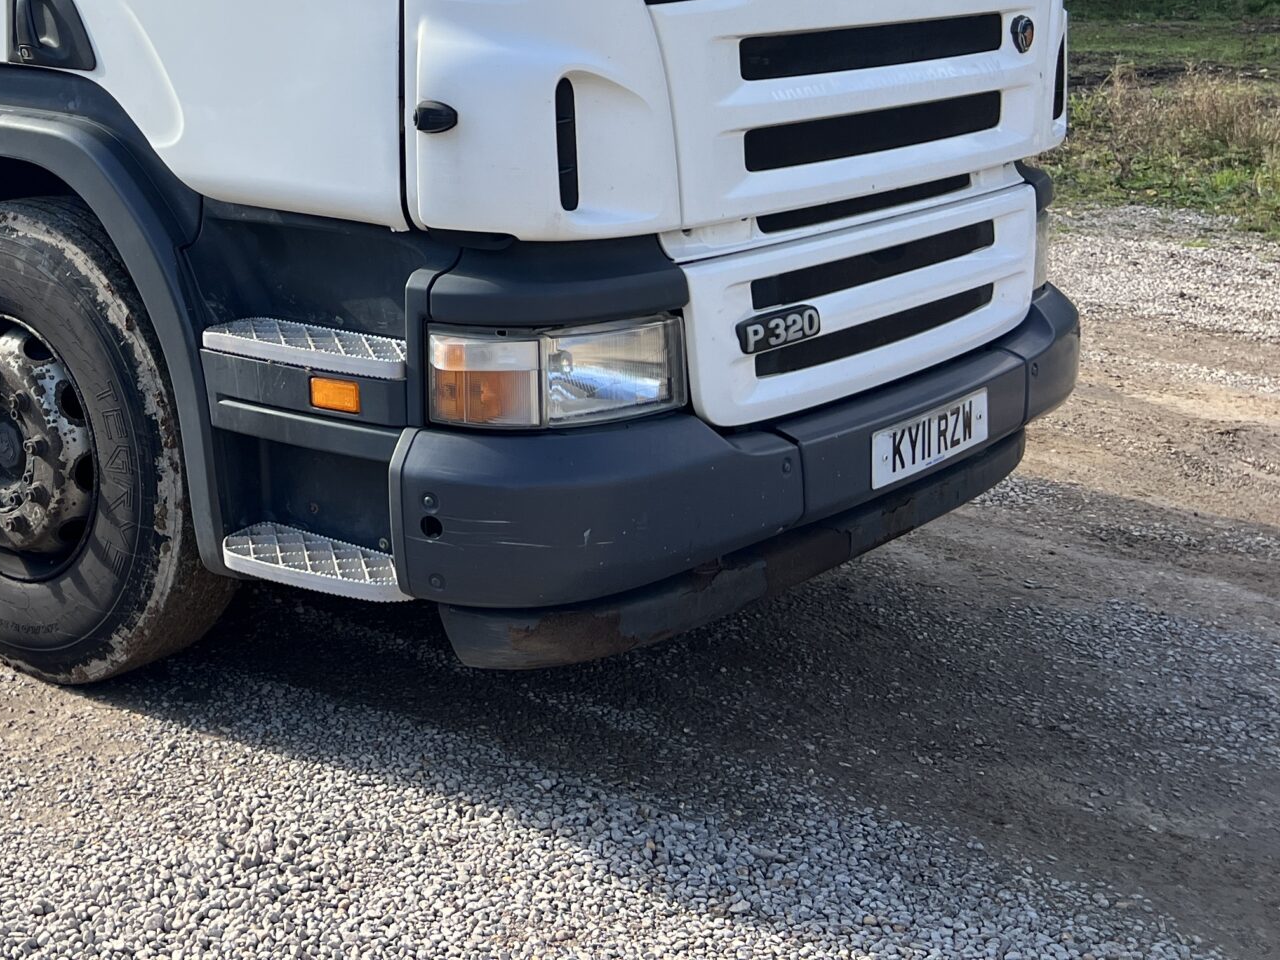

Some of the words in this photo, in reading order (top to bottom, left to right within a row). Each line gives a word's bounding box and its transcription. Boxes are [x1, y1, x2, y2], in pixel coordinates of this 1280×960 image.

[746, 323, 765, 353] P
[768, 309, 820, 346] 320
[892, 417, 932, 473] KY11
[937, 400, 973, 455] RZW
